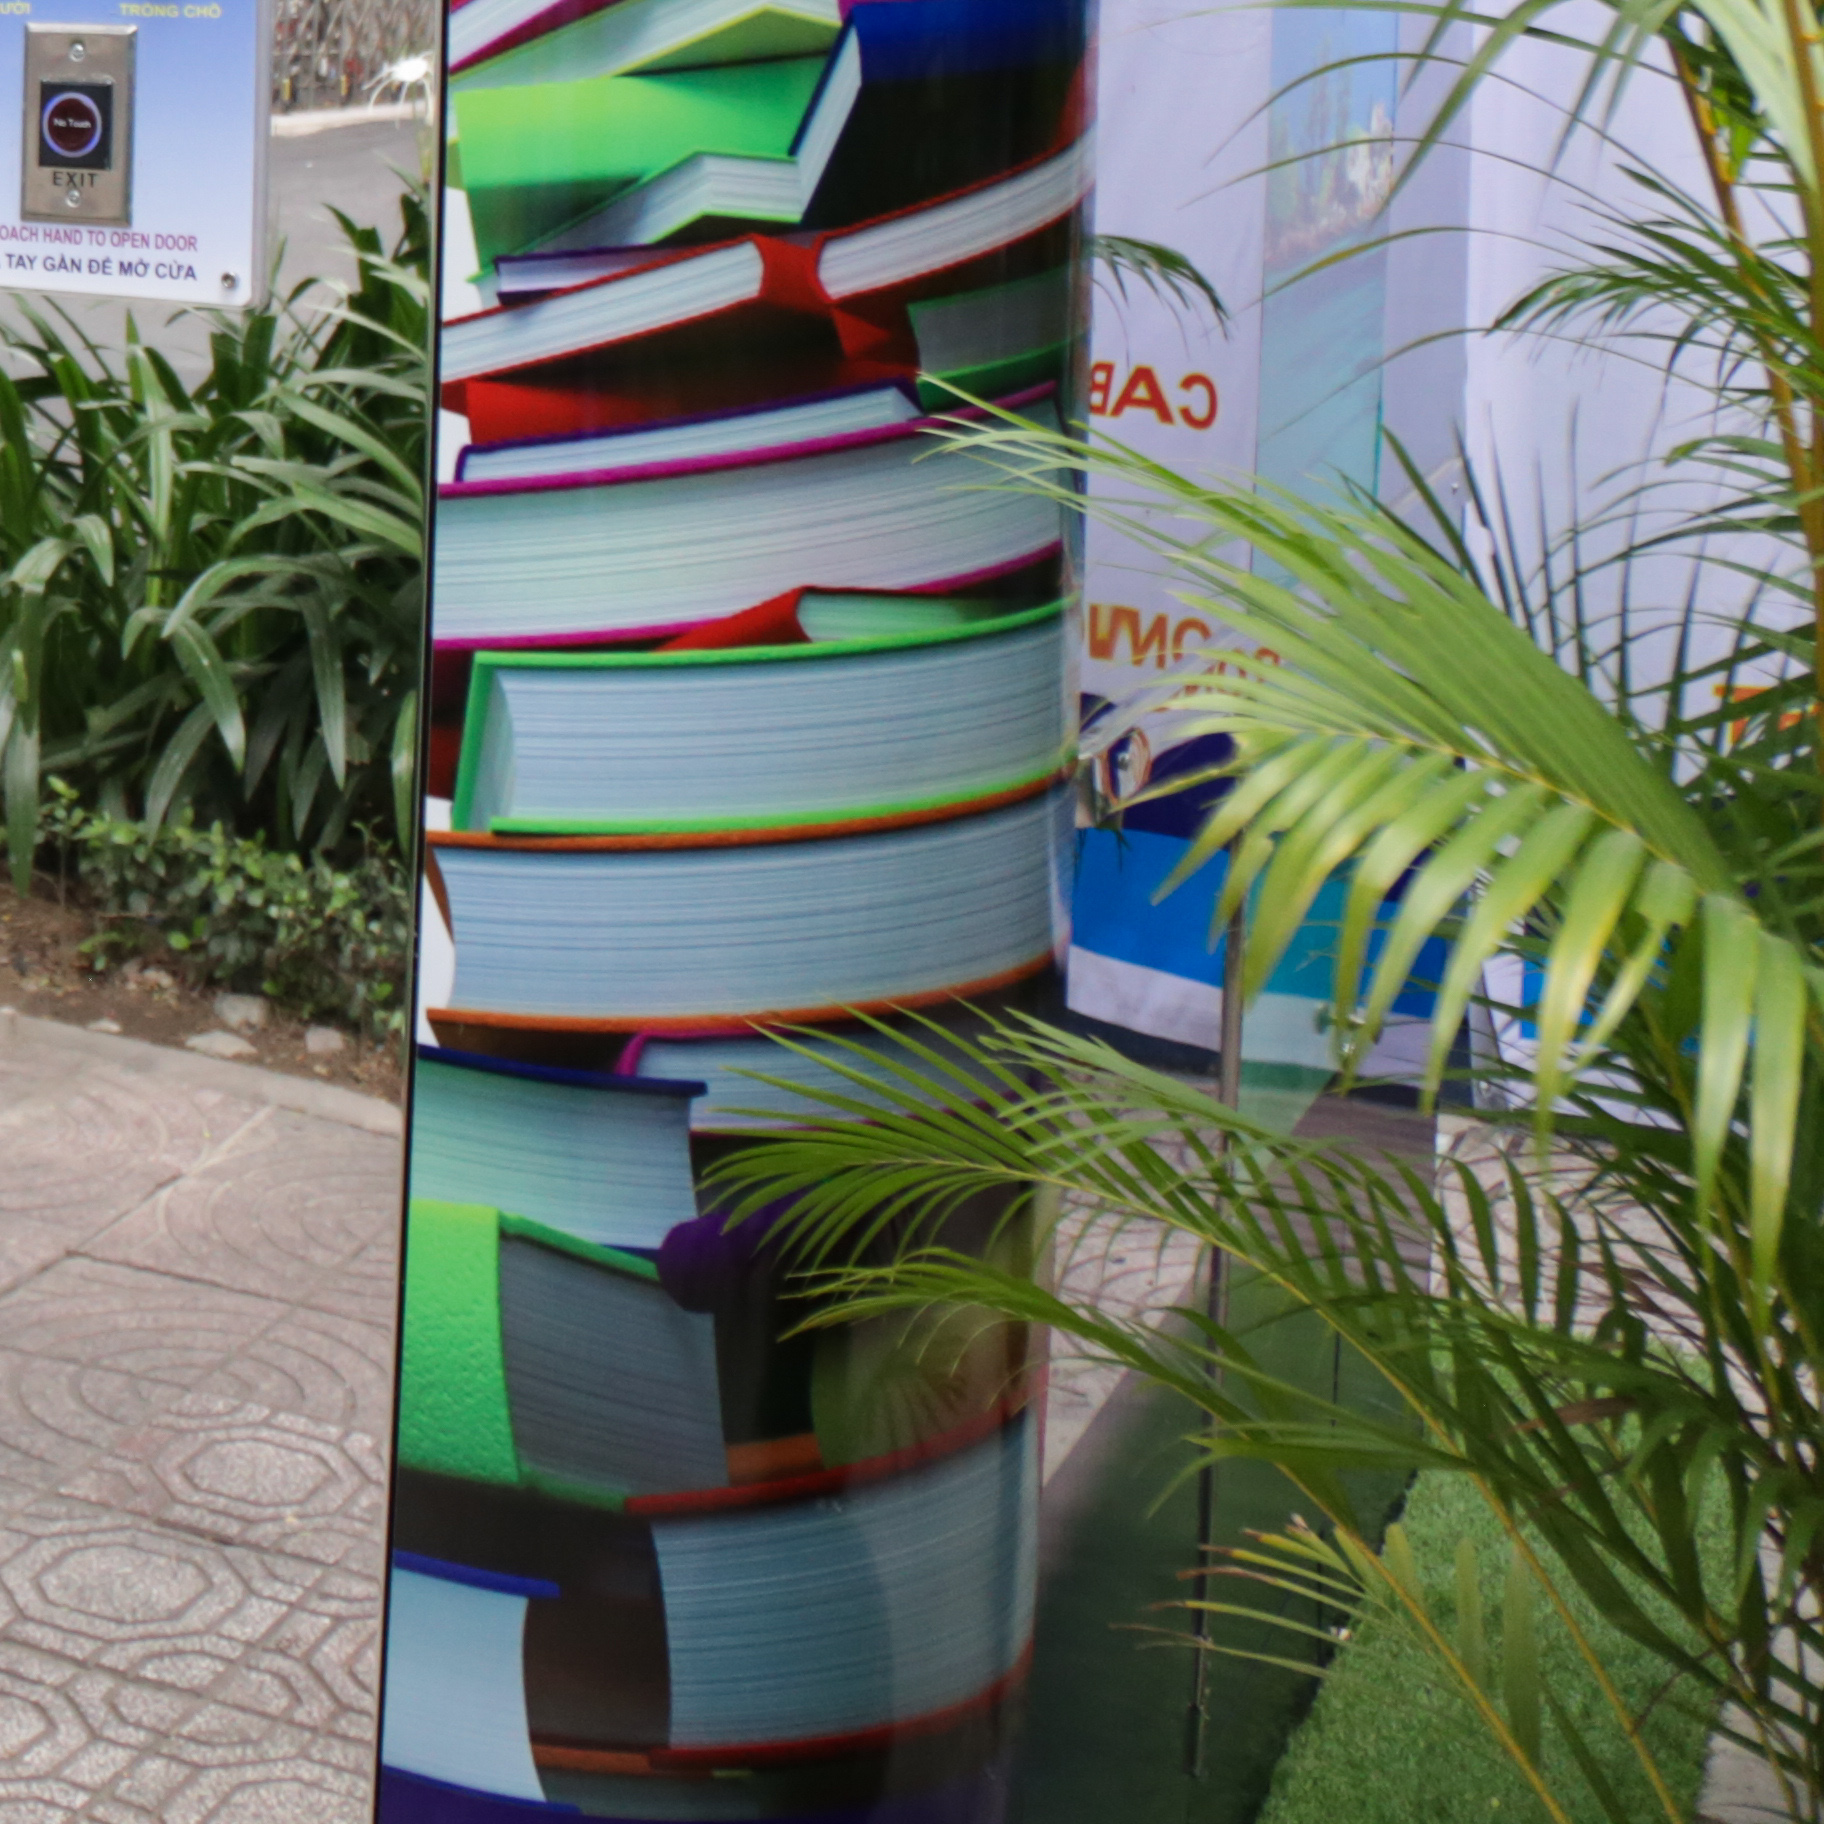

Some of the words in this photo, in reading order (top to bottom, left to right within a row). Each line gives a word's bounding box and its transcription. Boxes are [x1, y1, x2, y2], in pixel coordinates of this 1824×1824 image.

[52, 171, 99, 187] EXIT
[43, 228, 83, 245] HAND
[88, 230, 106, 247] TO
[110, 231, 150, 249] OPEN
[154, 234, 198, 252] DOOR
[6, 253, 37, 271] TAY
